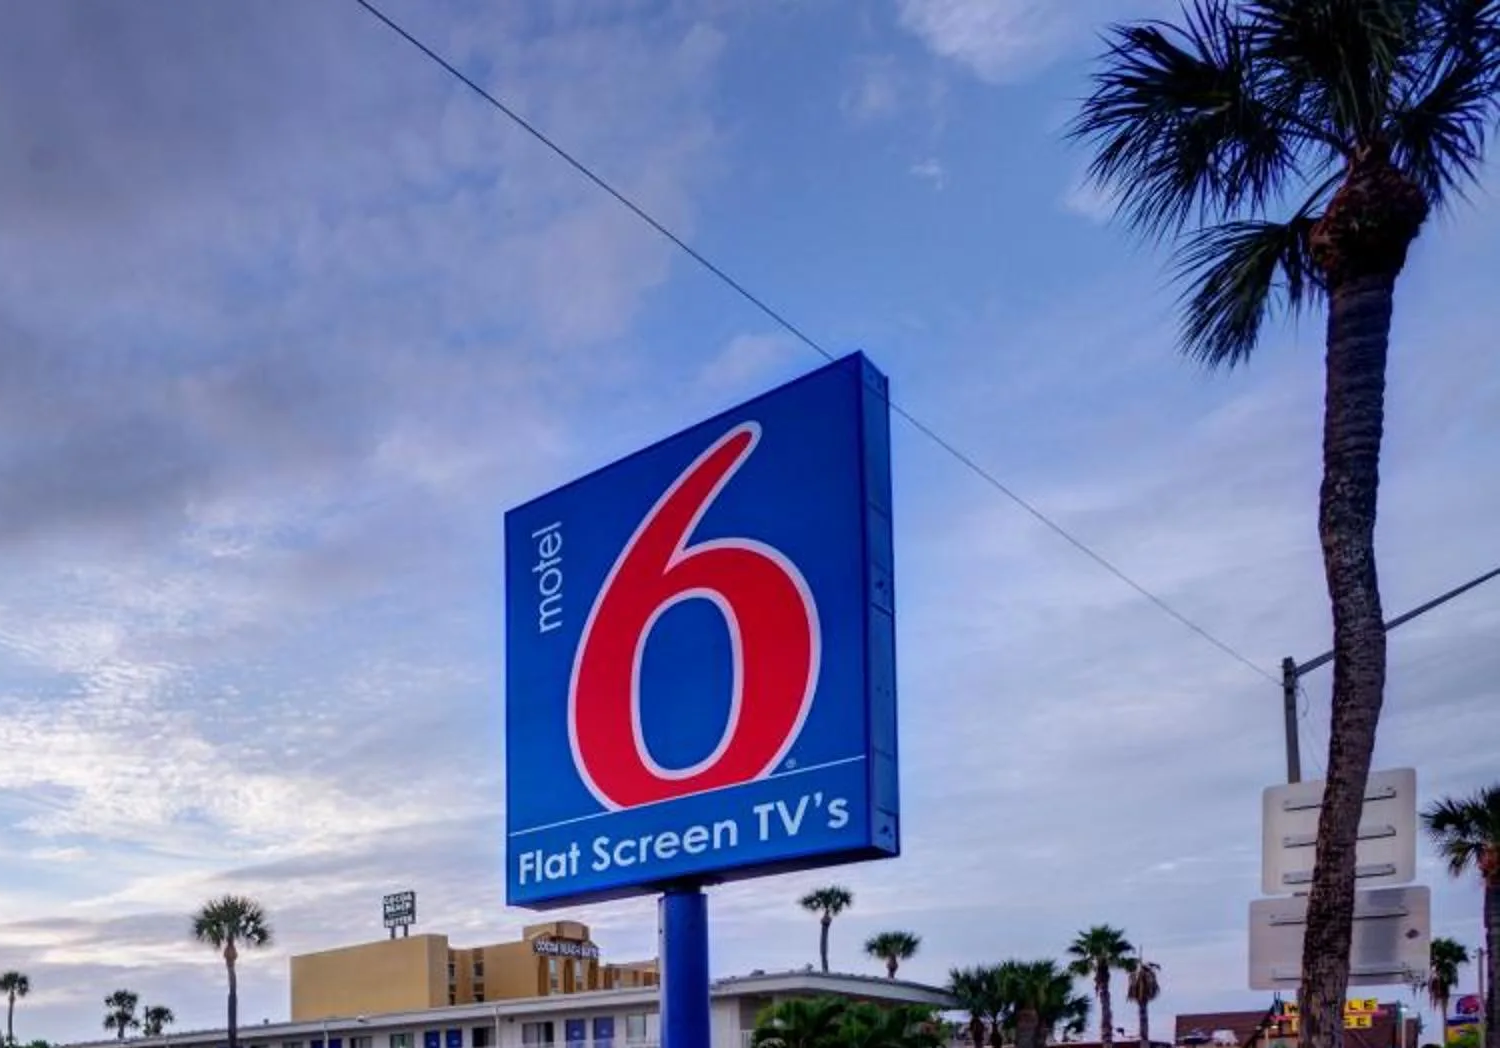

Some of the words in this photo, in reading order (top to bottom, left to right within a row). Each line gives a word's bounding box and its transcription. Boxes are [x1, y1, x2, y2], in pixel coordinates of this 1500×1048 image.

[531, 521, 563, 633] motel
[567, 420, 822, 813] 6
[518, 841, 581, 886] Flat
[592, 818, 738, 873] Screen
[752, 791, 850, 842] TV's
